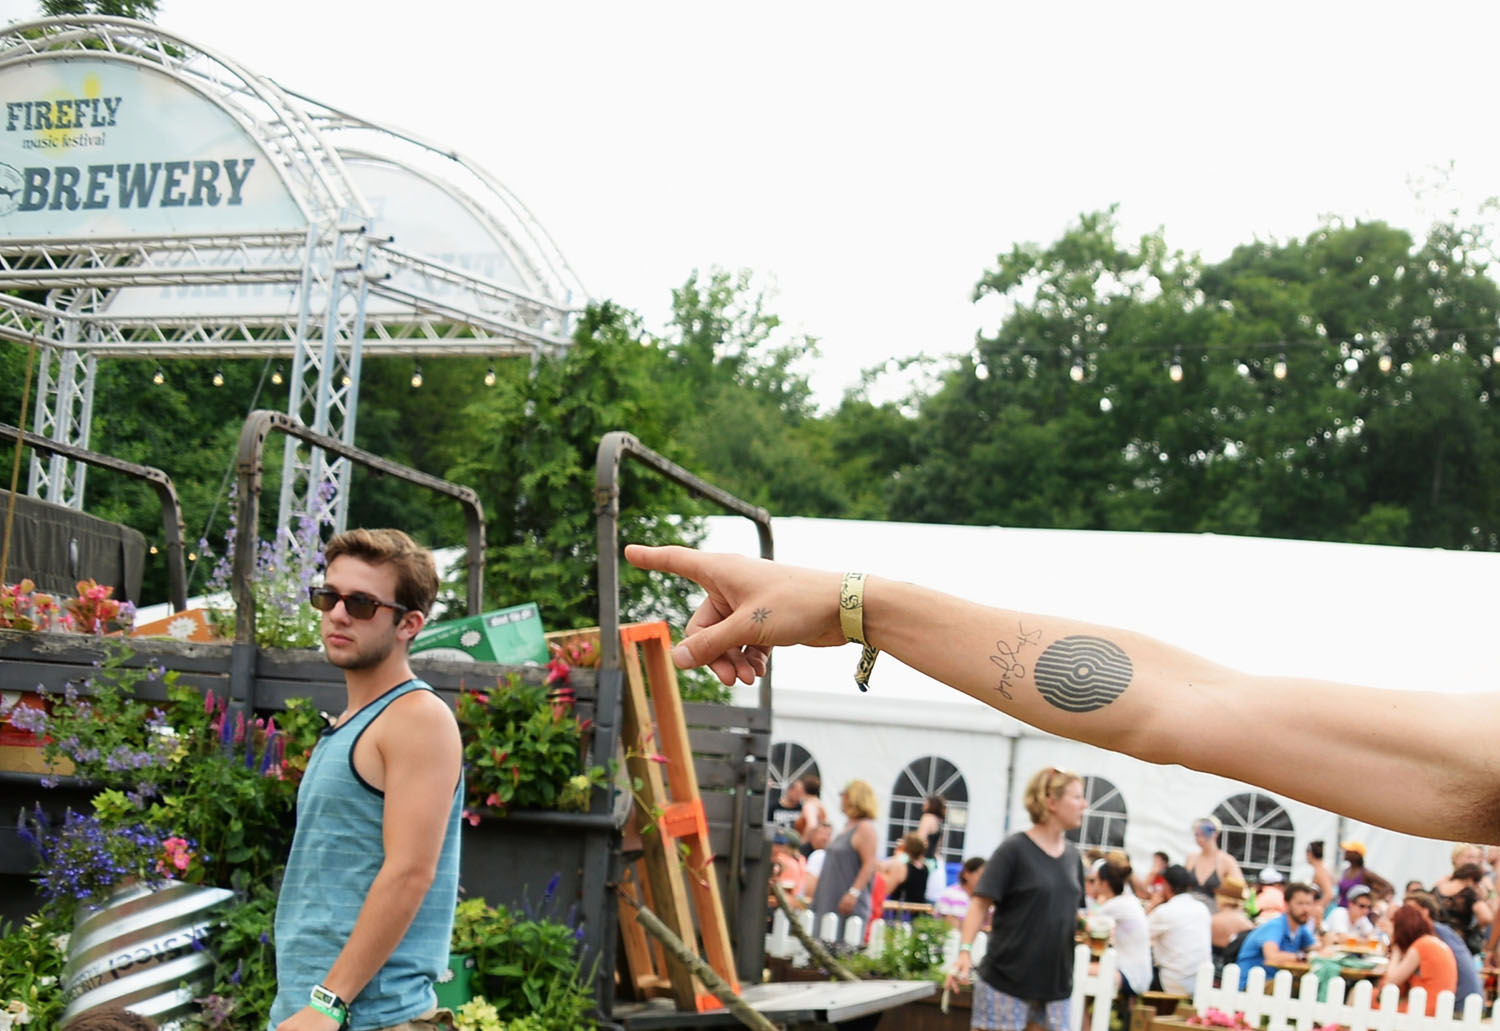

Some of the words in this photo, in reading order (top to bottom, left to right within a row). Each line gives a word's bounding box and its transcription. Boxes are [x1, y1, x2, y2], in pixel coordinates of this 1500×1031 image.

[6, 97, 122, 131] FIREFLY
[22, 135, 58, 149] music
[62, 131, 106, 148] festival
[18, 159, 255, 211] BREWERY
